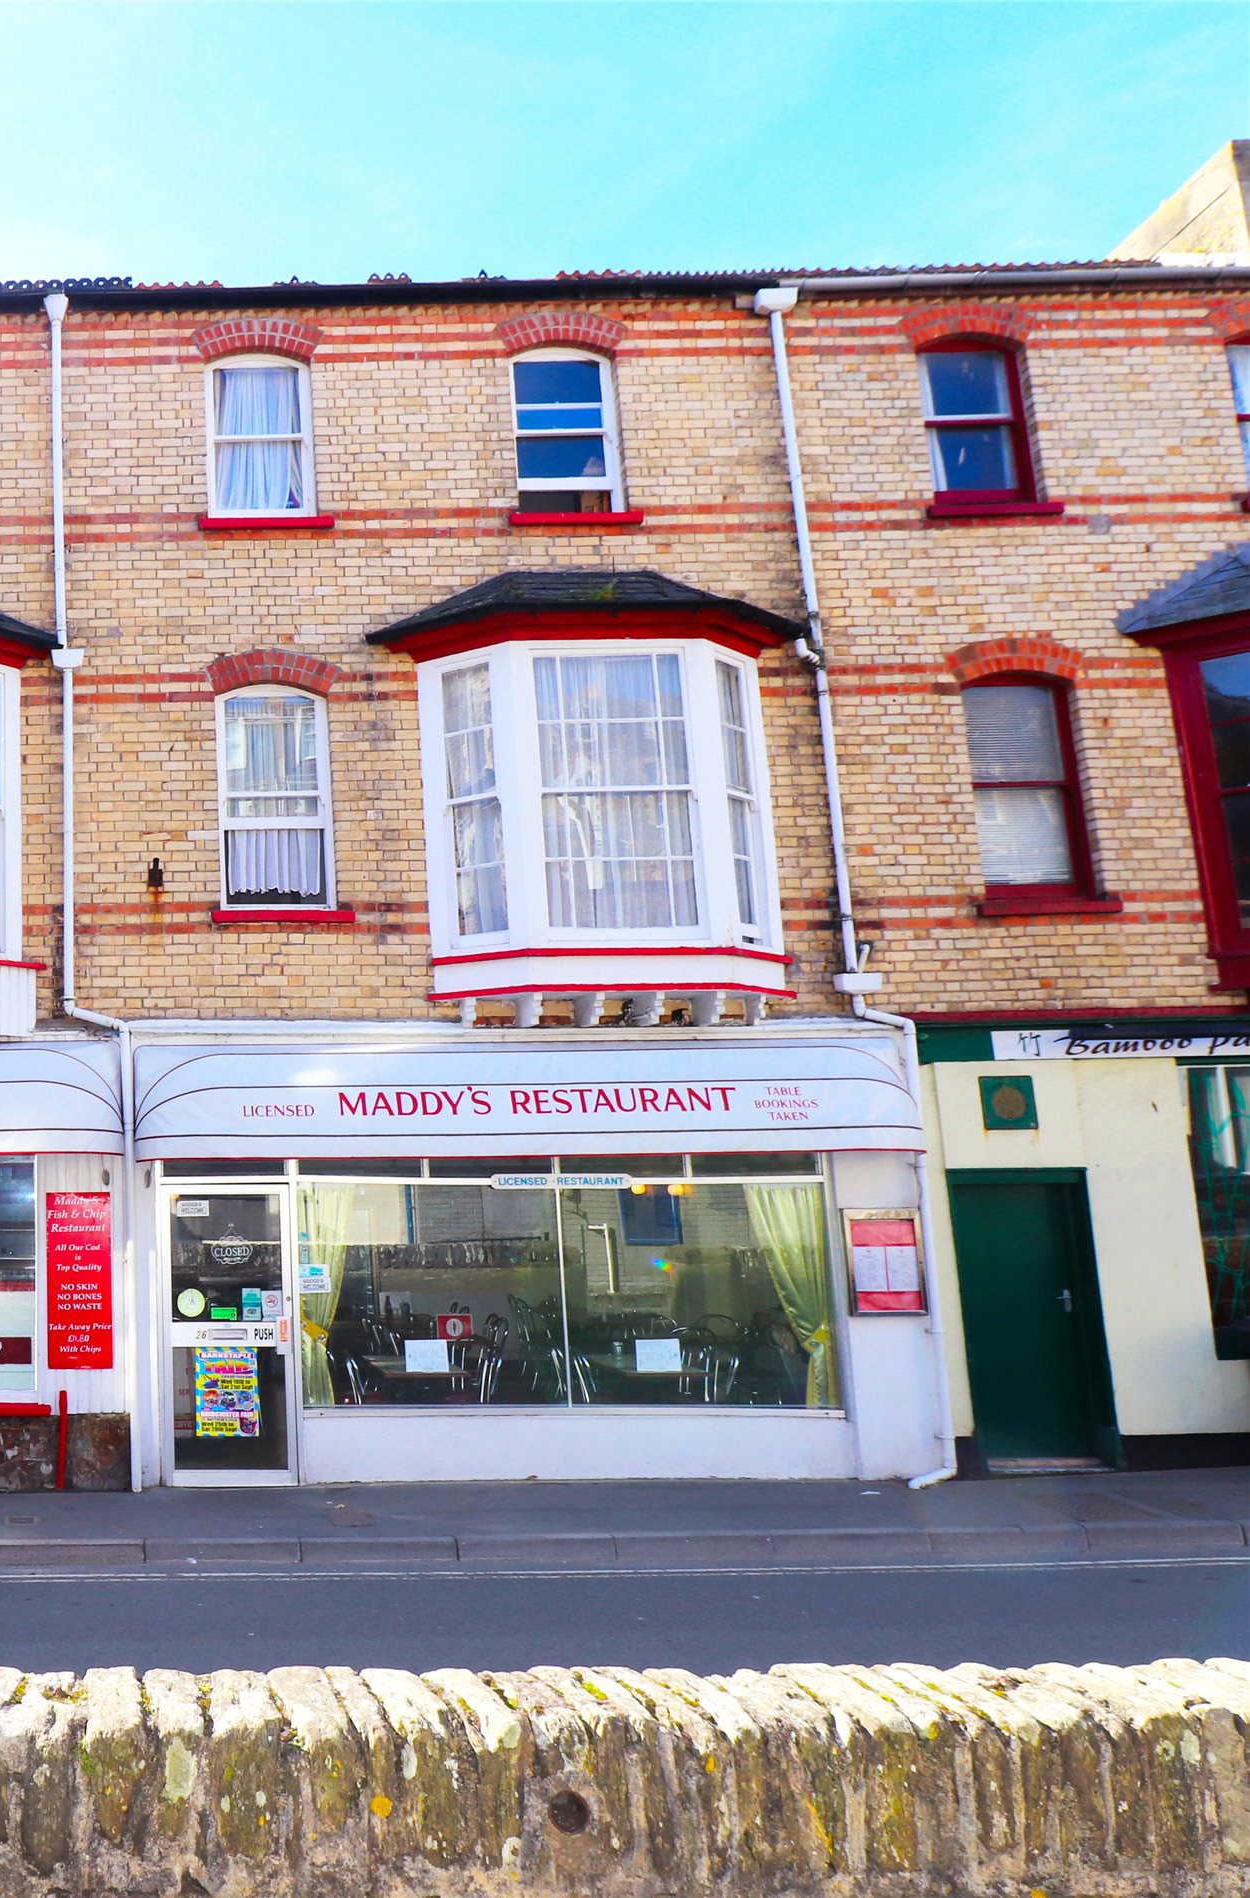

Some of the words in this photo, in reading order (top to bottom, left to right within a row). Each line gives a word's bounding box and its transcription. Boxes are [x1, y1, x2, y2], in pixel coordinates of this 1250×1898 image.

[1018, 1032, 1041, 1057] 竹
[765, 1086, 802, 1096] TABLE
[338, 1086, 492, 1116] MADDY'S
[509, 1086, 737, 1114] RESTAURANT
[754, 1099, 819, 1109] BOOKINGS
[242, 1104, 315, 1118] LICENSED
[768, 1111, 809, 1121] TAKEN
[498, 1177, 548, 1186] LICENSED
[557, 1176, 624, 1186] RESTAURANT
[47, 1209, 68, 1219] Fish
[71, 1209, 79, 1219] &
[83, 1209, 106, 1221] Chip
[51, 1223, 105, 1233] Restaurant
[214, 1246, 250, 1257] CLOSED
[74, 1253, 82, 1261] is
[56, 1264, 70, 1272] Top
[72, 1263, 102, 1273] Quality
[61, 1283, 74, 1291] NO
[76, 1283, 98, 1291] SKIN
[57, 1293, 71, 1301] NO
[73, 1293, 102, 1301] BONES
[57, 1303, 71, 1311] NO
[49, 1323, 66, 1331] Take
[68, 1323, 90, 1332] Away
[93, 1322, 112, 1330] Price
[196, 1330, 207, 1340] 26
[253, 1328, 274, 1340] PUSH
[59, 1345, 78, 1353] With
[80, 1345, 102, 1354] Chips
